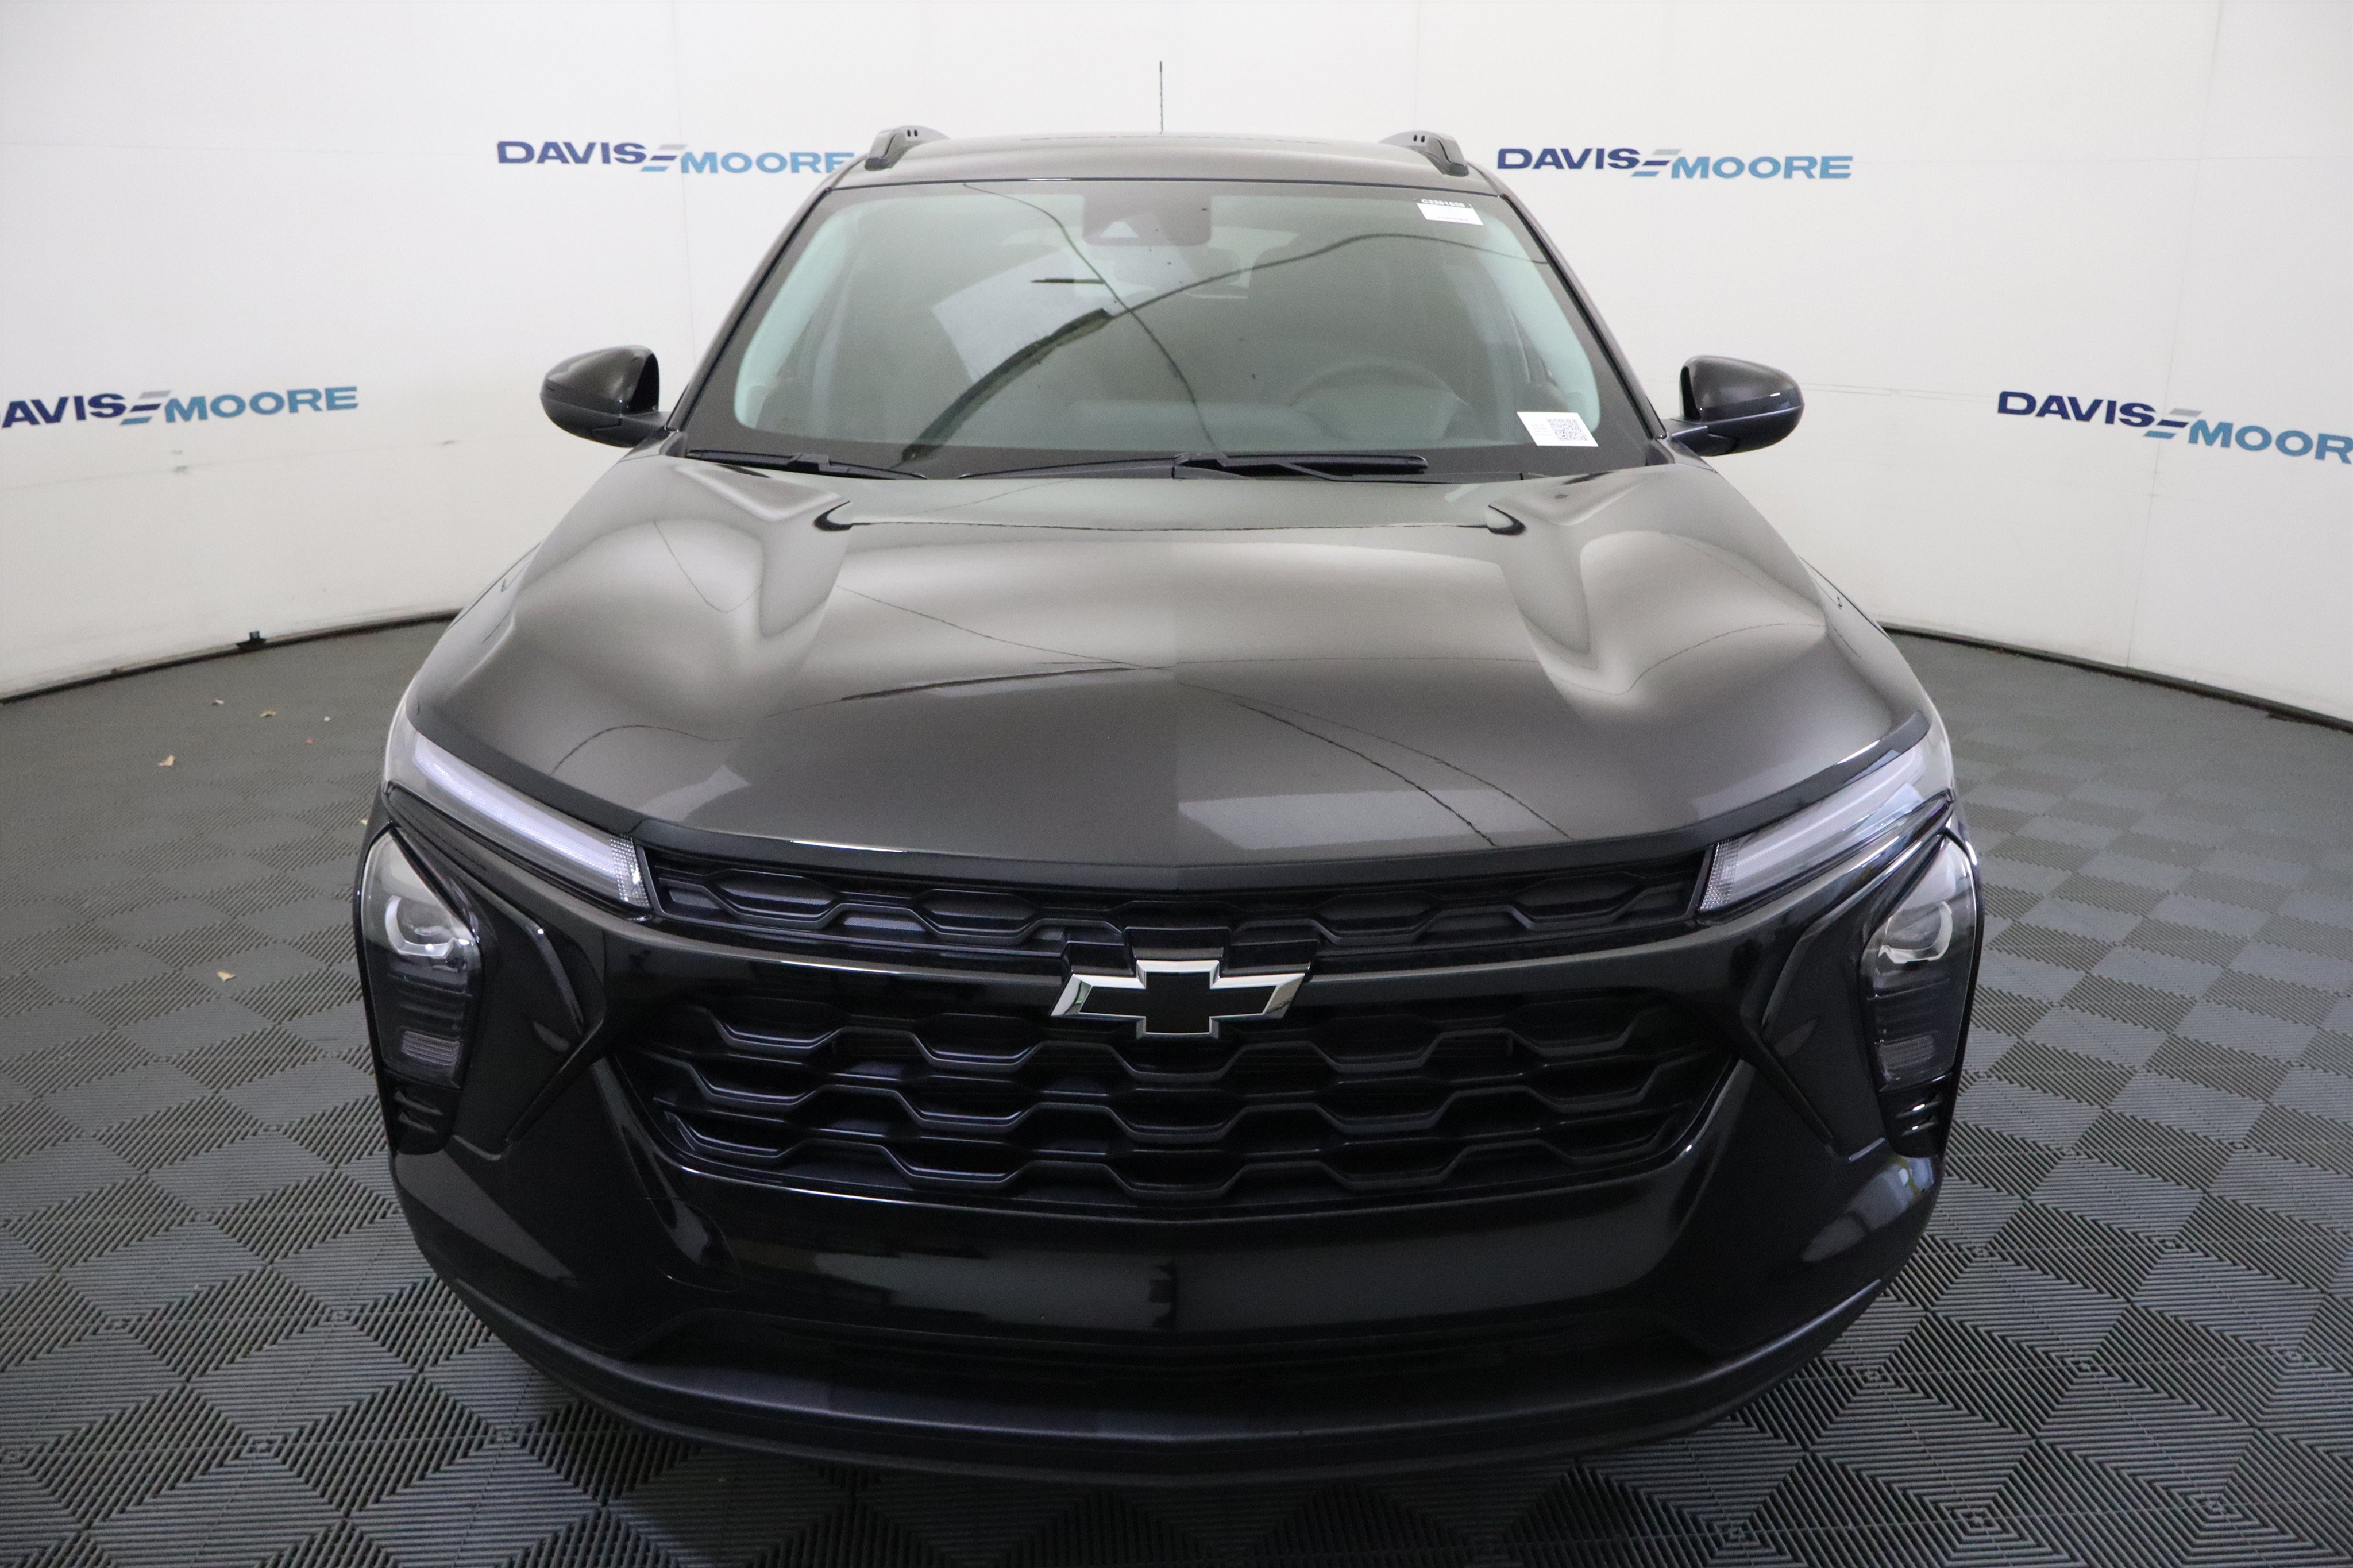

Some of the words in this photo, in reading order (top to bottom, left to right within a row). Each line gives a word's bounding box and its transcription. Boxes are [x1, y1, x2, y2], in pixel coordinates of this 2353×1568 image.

[497, 141, 647, 165] DAVIS
[1497, 148, 1640, 170] DAVIS
[1671, 156, 1853, 179] MOORE
[2, 392, 127, 428] AVIS
[164, 386, 358, 424] MOORE
[1997, 391, 2156, 427] DAVIS
[2188, 419, 2353, 464] MOOR
